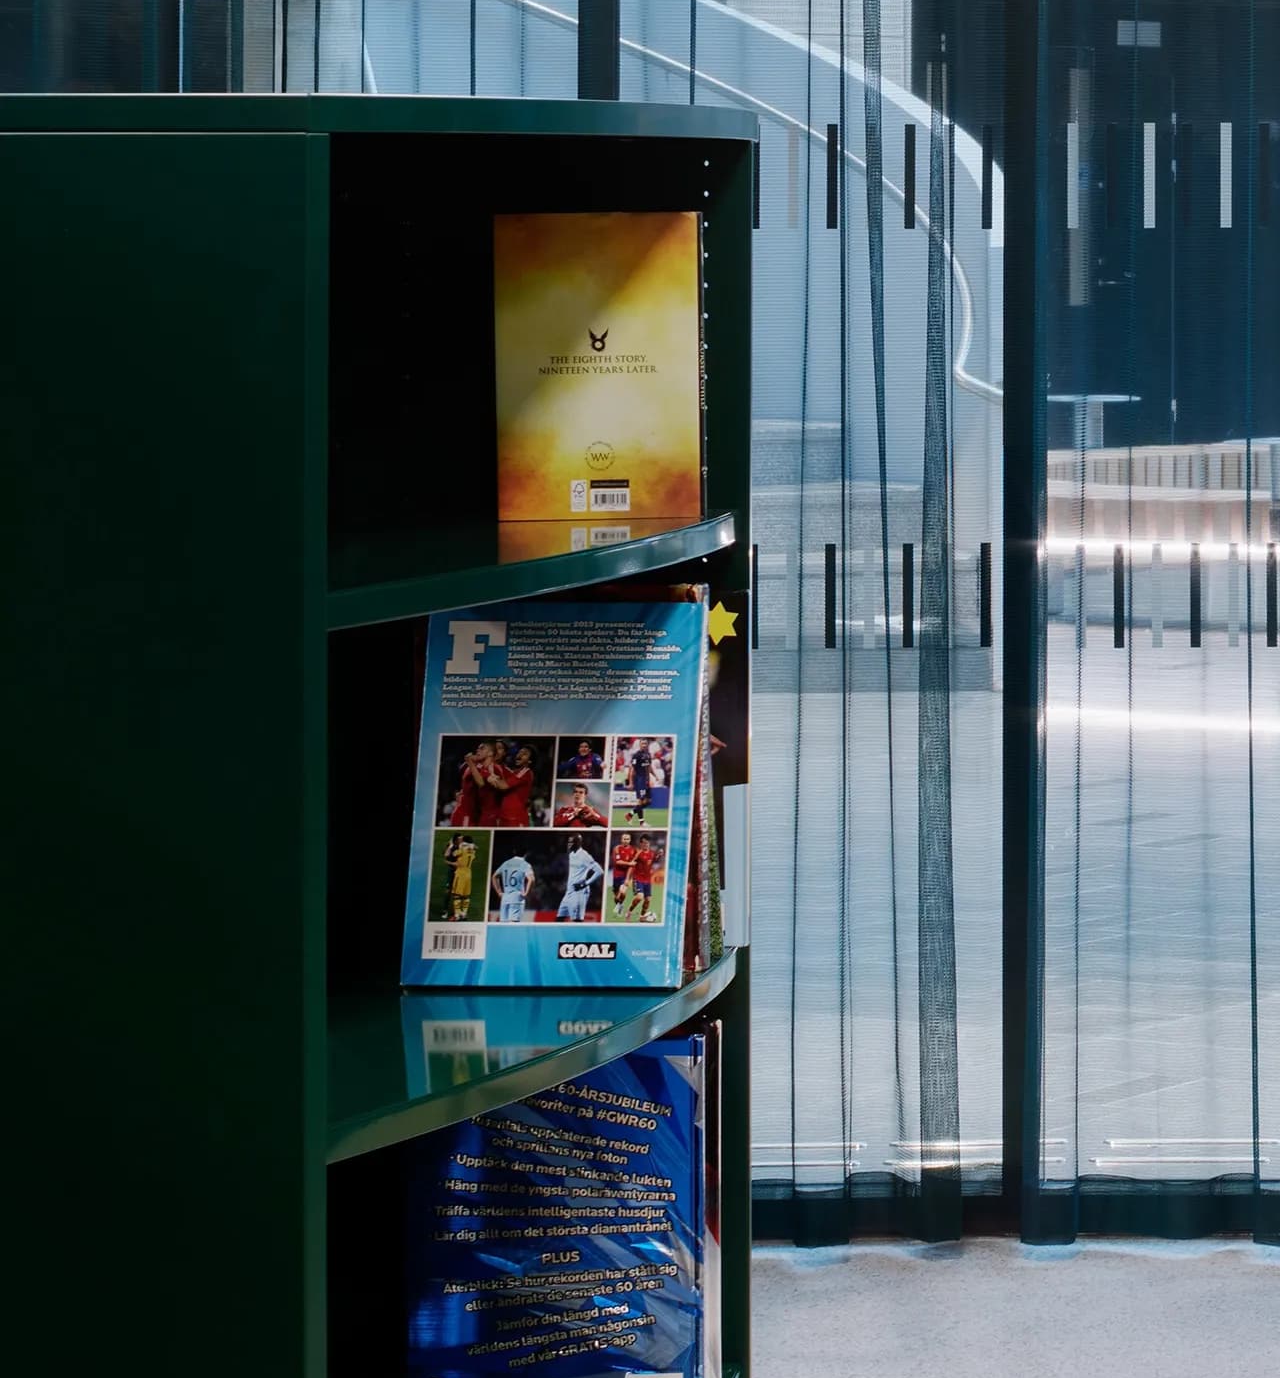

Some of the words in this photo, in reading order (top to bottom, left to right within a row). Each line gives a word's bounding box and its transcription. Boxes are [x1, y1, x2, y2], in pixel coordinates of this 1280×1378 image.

[538, 366, 590, 375] NINETEEN
[592, 365, 624, 374] YEARS
[550, 356, 569, 364] THE
[573, 355, 612, 364] EIGHTH
[503, 869, 518, 887] 16
[559, 943, 615, 958] GOAL
[558, 1083, 673, 1117] 60-ÅRSJUBILEUM
[576, 1106, 594, 1120] på
[596, 1108, 658, 1131] #GWR60
[491, 1137, 514, 1148] och
[571, 1148, 594, 1160] nya
[596, 1150, 629, 1165] foton
[530, 1124, 608, 1146] uppdaterade
[608, 1140, 650, 1154] rekord
[456, 1153, 509, 1169] Upptäck
[510, 1160, 534, 1173] den
[535, 1165, 568, 1177] mest
[568, 1167, 630, 1183] stinkande
[631, 1172, 672, 1188] lukten
[444, 1179, 479, 1193] Häng
[480, 1182, 509, 1193] med
[510, 1183, 527, 1193] de
[528, 1185, 569, 1198] yngsta
[571, 1186, 676, 1202] polaräventyrarna
[434, 1205, 470, 1217] Träffa
[472, 1205, 527, 1217] världens
[528, 1205, 616, 1220] intelligentaste
[617, 1206, 666, 1219] husdjur
[434, 1230, 455, 1241] Lär
[456, 1229, 478, 1242] dig
[478, 1227, 500, 1239] allt
[501, 1229, 523, 1238] om
[524, 1226, 545, 1237] det
[546, 1224, 589, 1237] största
[541, 1250, 581, 1264] PLUS
[505, 1277, 522, 1288] Se
[524, 1276, 547, 1287] hur
[548, 1270, 604, 1285] rekorden
[605, 1269, 626, 1280] har
[628, 1264, 657, 1279] stått
[658, 1262, 678, 1277] sig
[464, 1300, 495, 1312] eller
[547, 1289, 563, 1301] de
[565, 1284, 613, 1298] senaste
[615, 1282, 633, 1293] 60
[635, 1278, 664, 1291] åren
[540, 1313, 561, 1325] din
[563, 1307, 599, 1322] längd
[601, 1303, 630, 1317] med
[466, 1339, 520, 1357] världens
[521, 1331, 568, 1347] längsta
[569, 1325, 597, 1338] man
[598, 1314, 656, 1334] någonsin
[508, 1353, 536, 1368] med
[537, 1349, 556, 1362] vår
[560, 1333, 636, 1357] GRATIS-app
